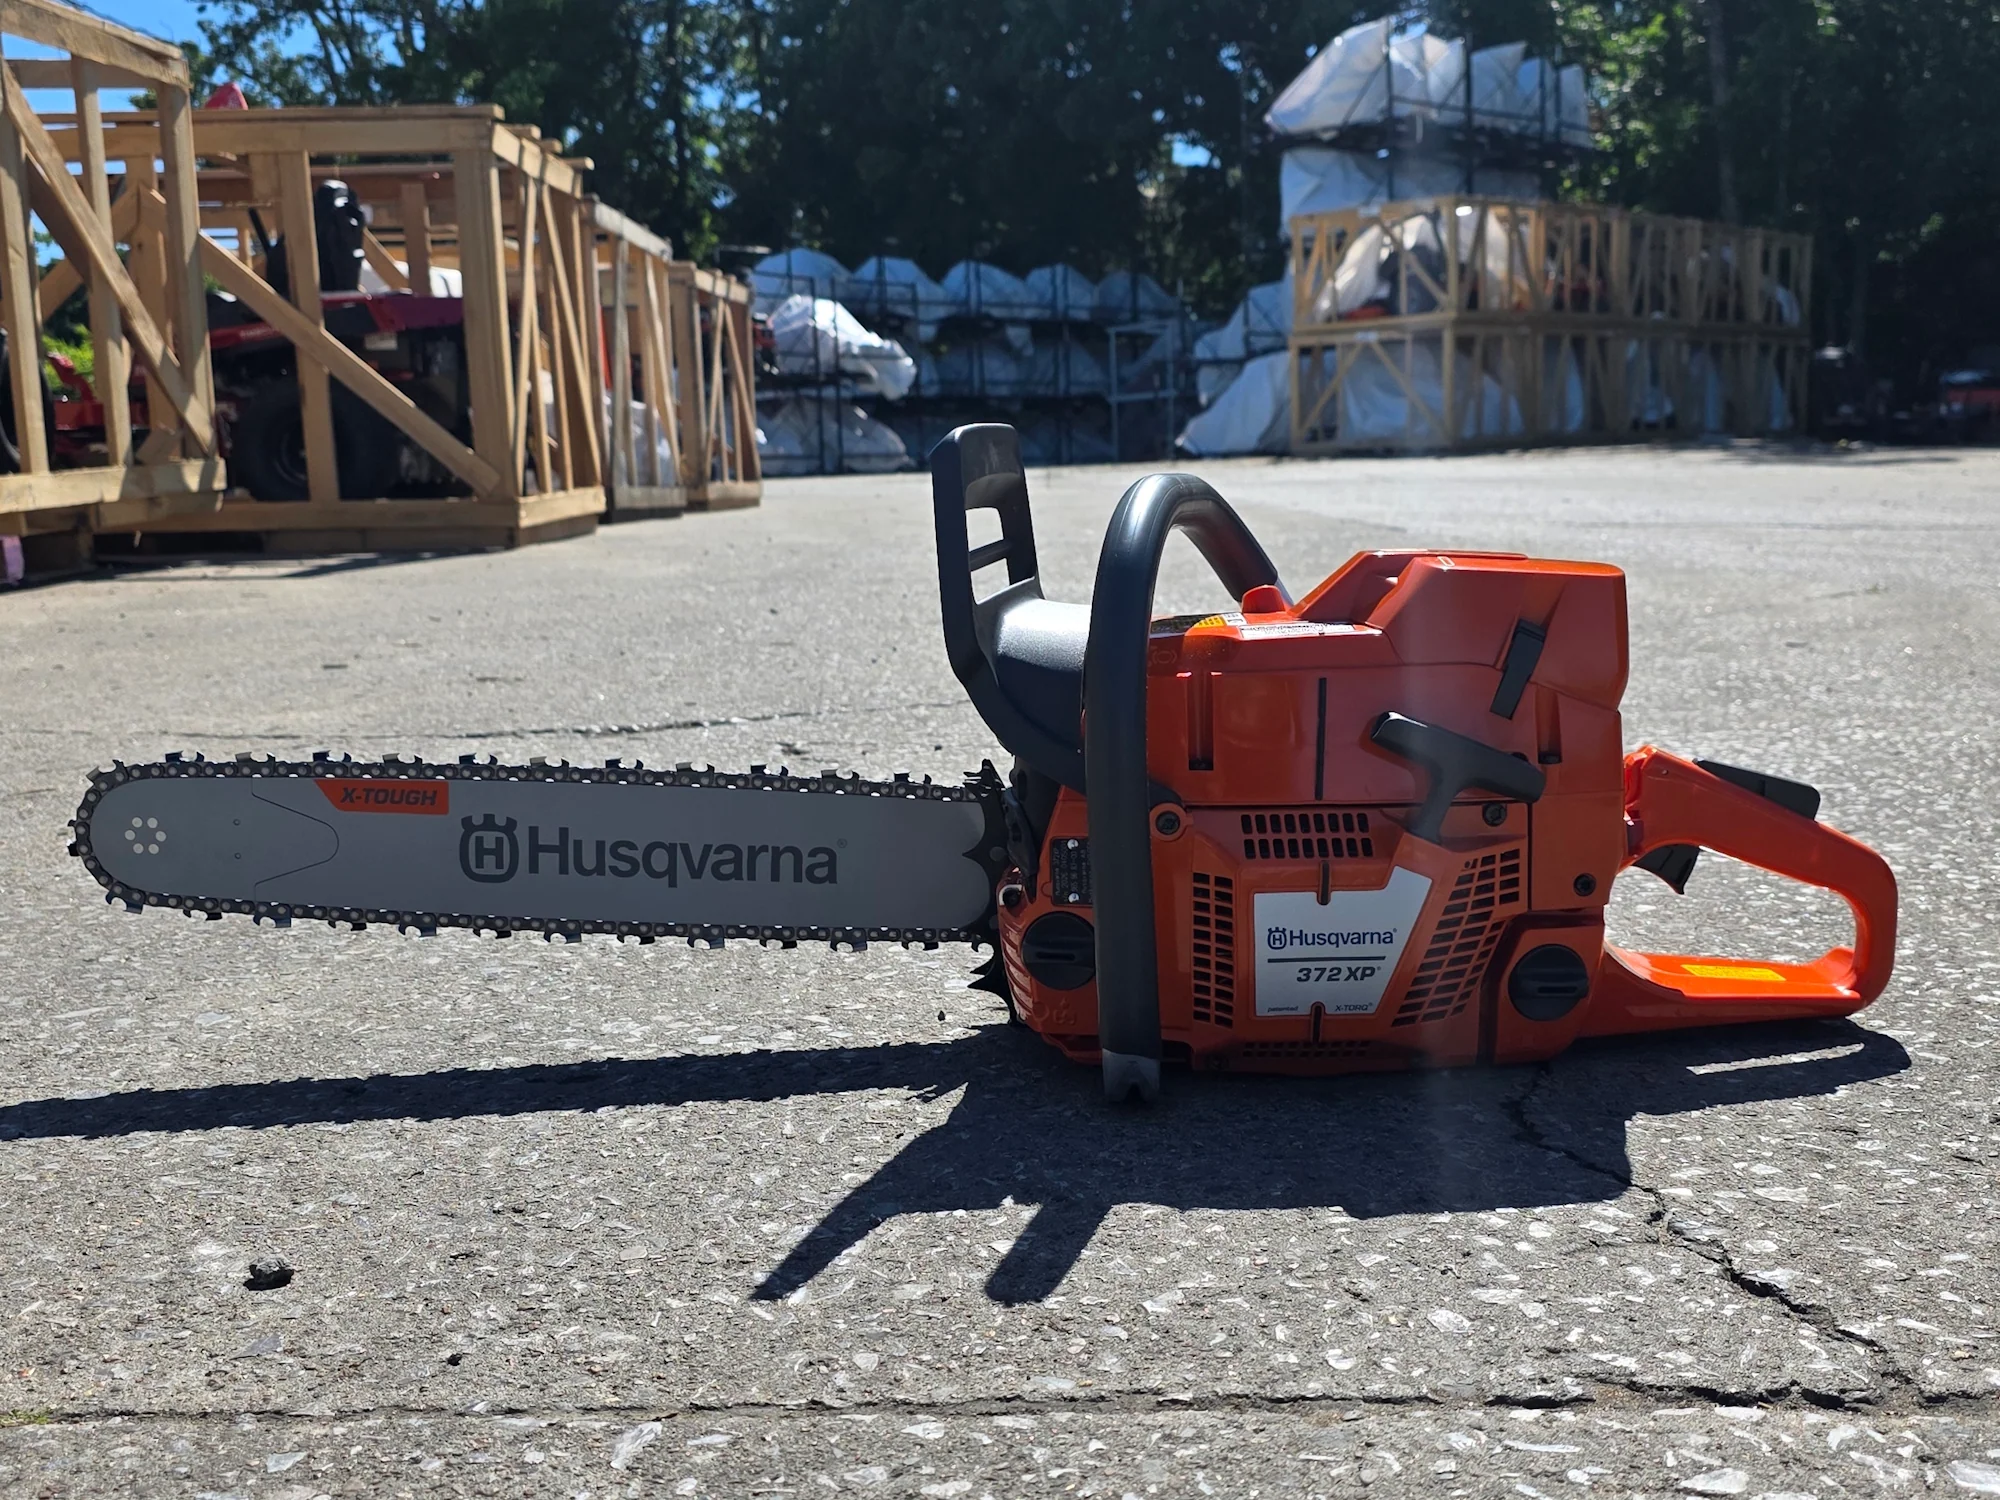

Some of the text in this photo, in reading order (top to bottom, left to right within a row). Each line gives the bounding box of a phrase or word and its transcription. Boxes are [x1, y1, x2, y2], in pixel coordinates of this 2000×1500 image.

[340, 787, 438, 806] X-TOUGH
[527, 825, 838, 888] Husqvarna
[1289, 929, 1394, 948] Husqvarna
[1296, 966, 1376, 982] 372XP
[1334, 1003, 1370, 1012] X-TORQ
